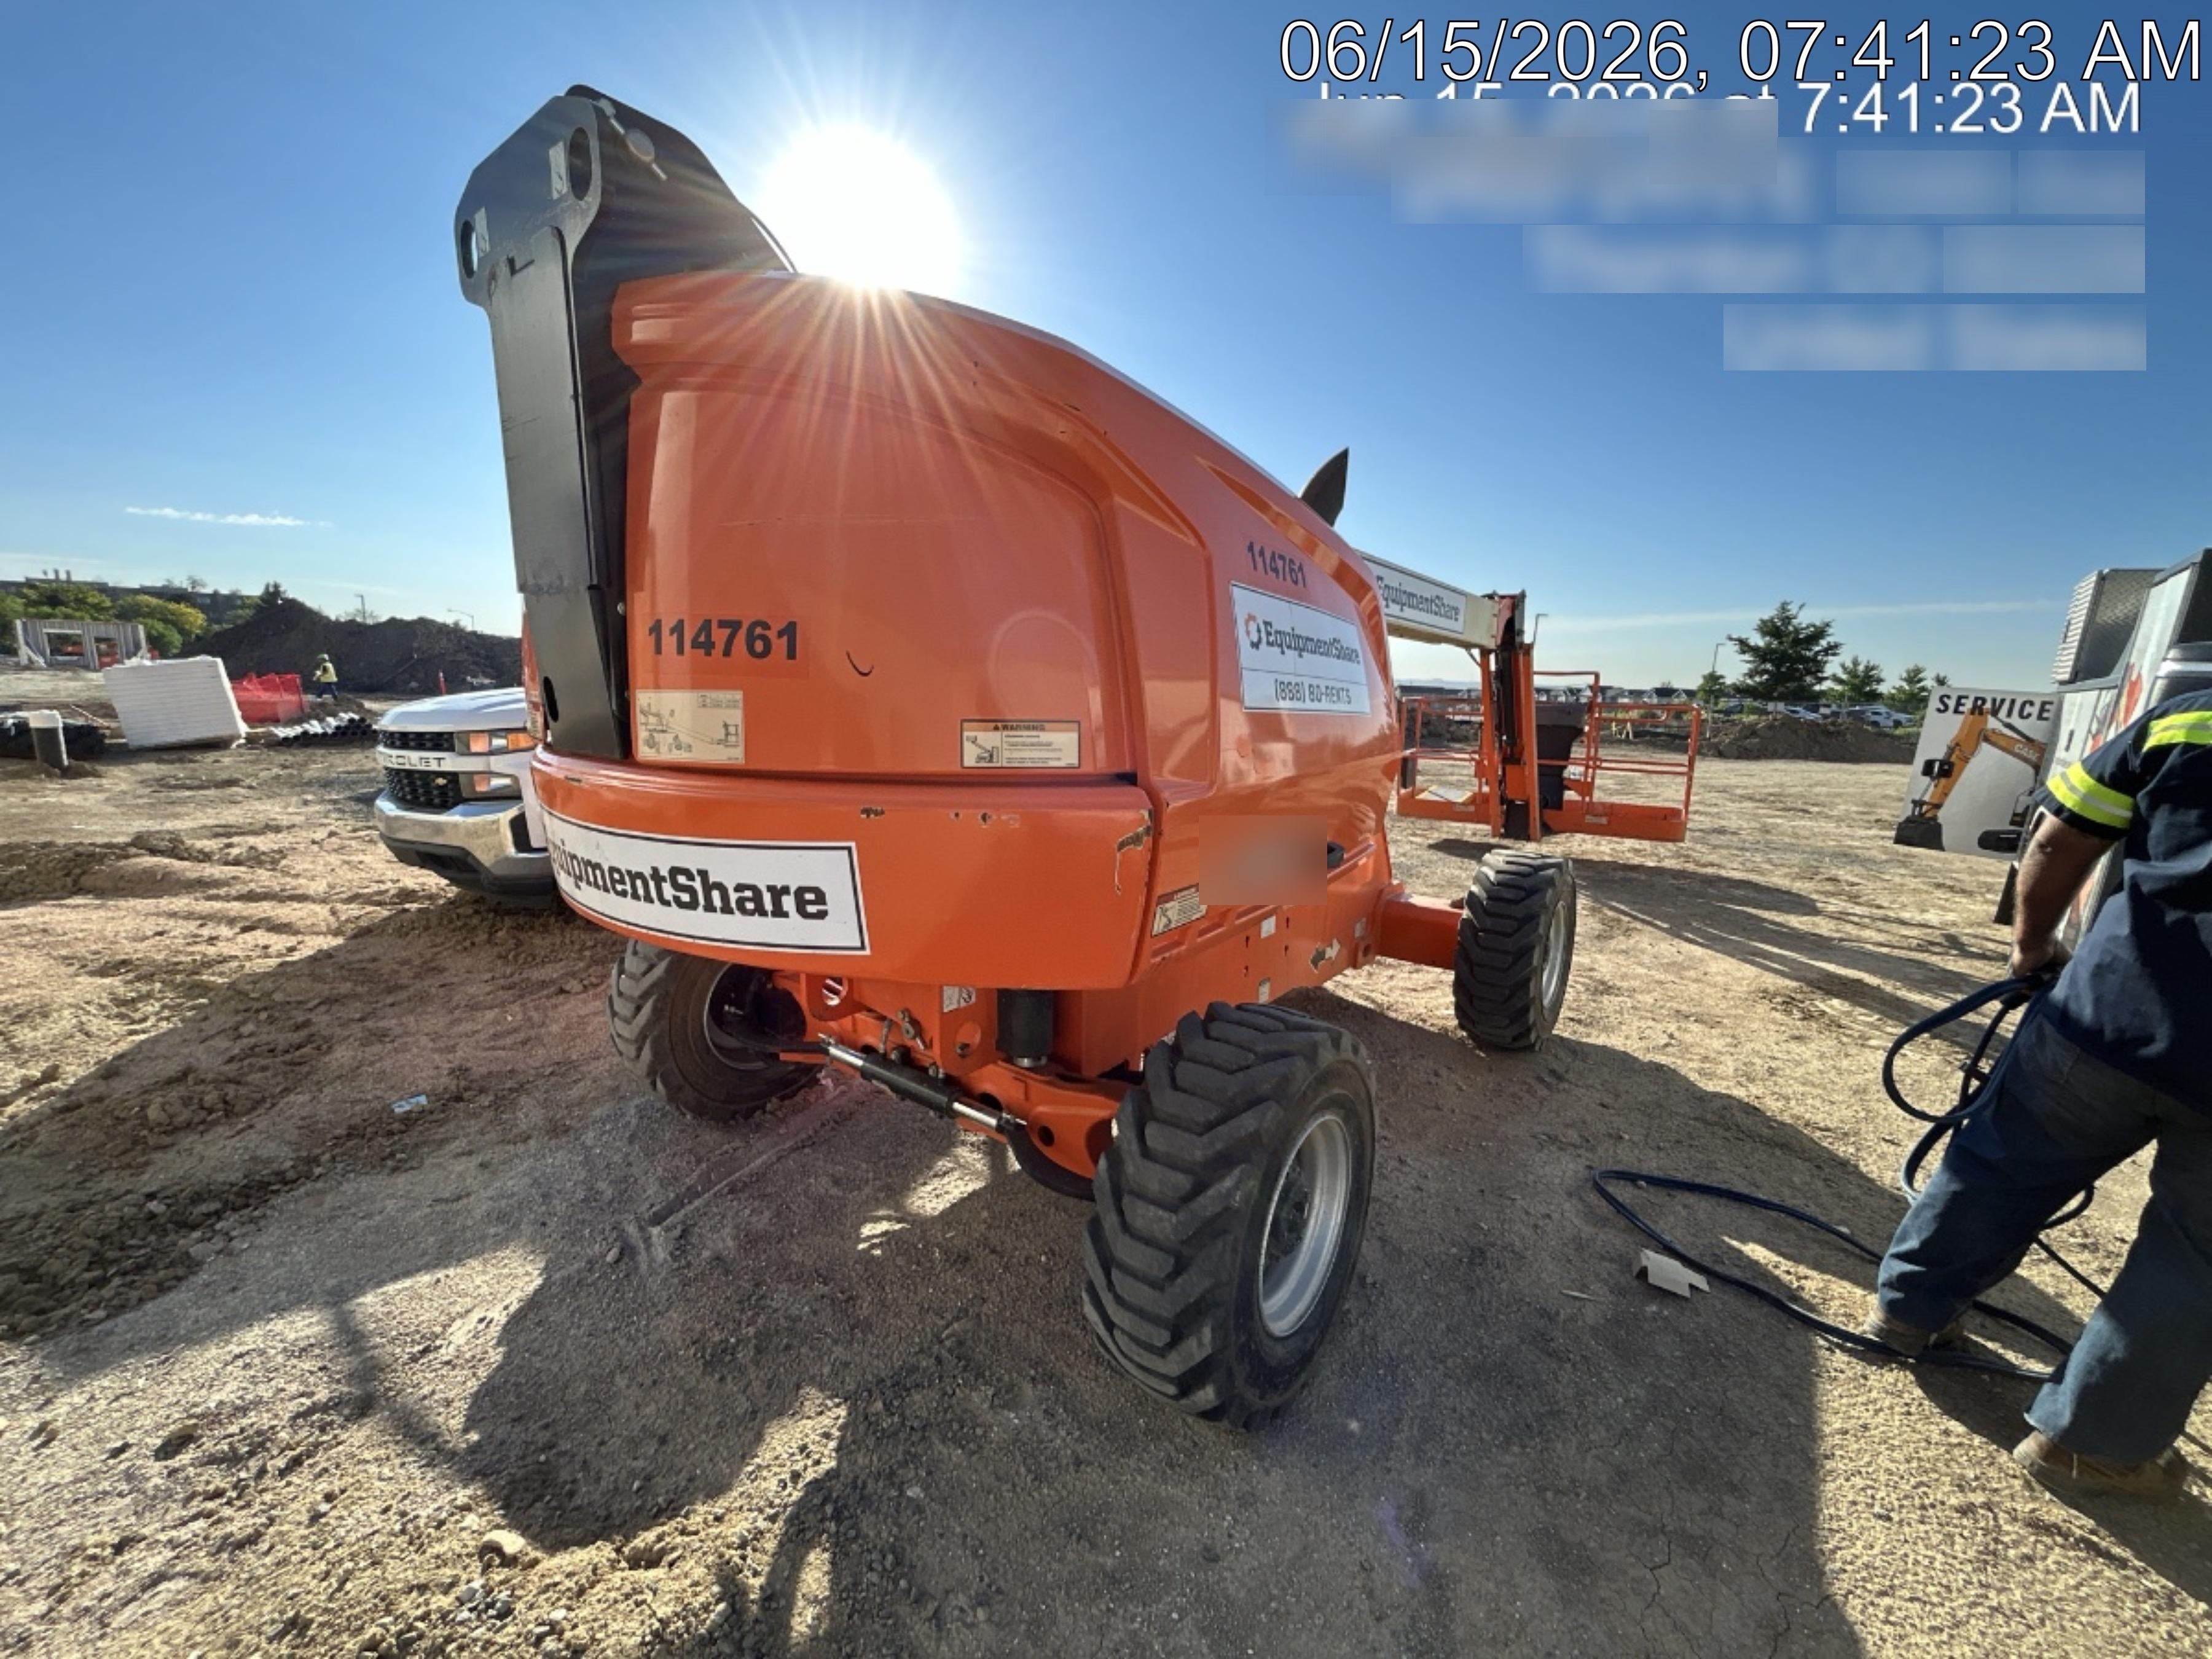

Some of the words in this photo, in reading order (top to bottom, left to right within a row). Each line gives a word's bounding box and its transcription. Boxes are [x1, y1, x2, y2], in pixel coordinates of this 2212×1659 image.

[1247, 541, 1307, 588] 114761
[648, 618, 798, 661] 114761
[1263, 619, 1361, 665] EquipmentShare
[1274, 678, 1306, 704] (888)
[1936, 694, 2054, 721] SERVICE
